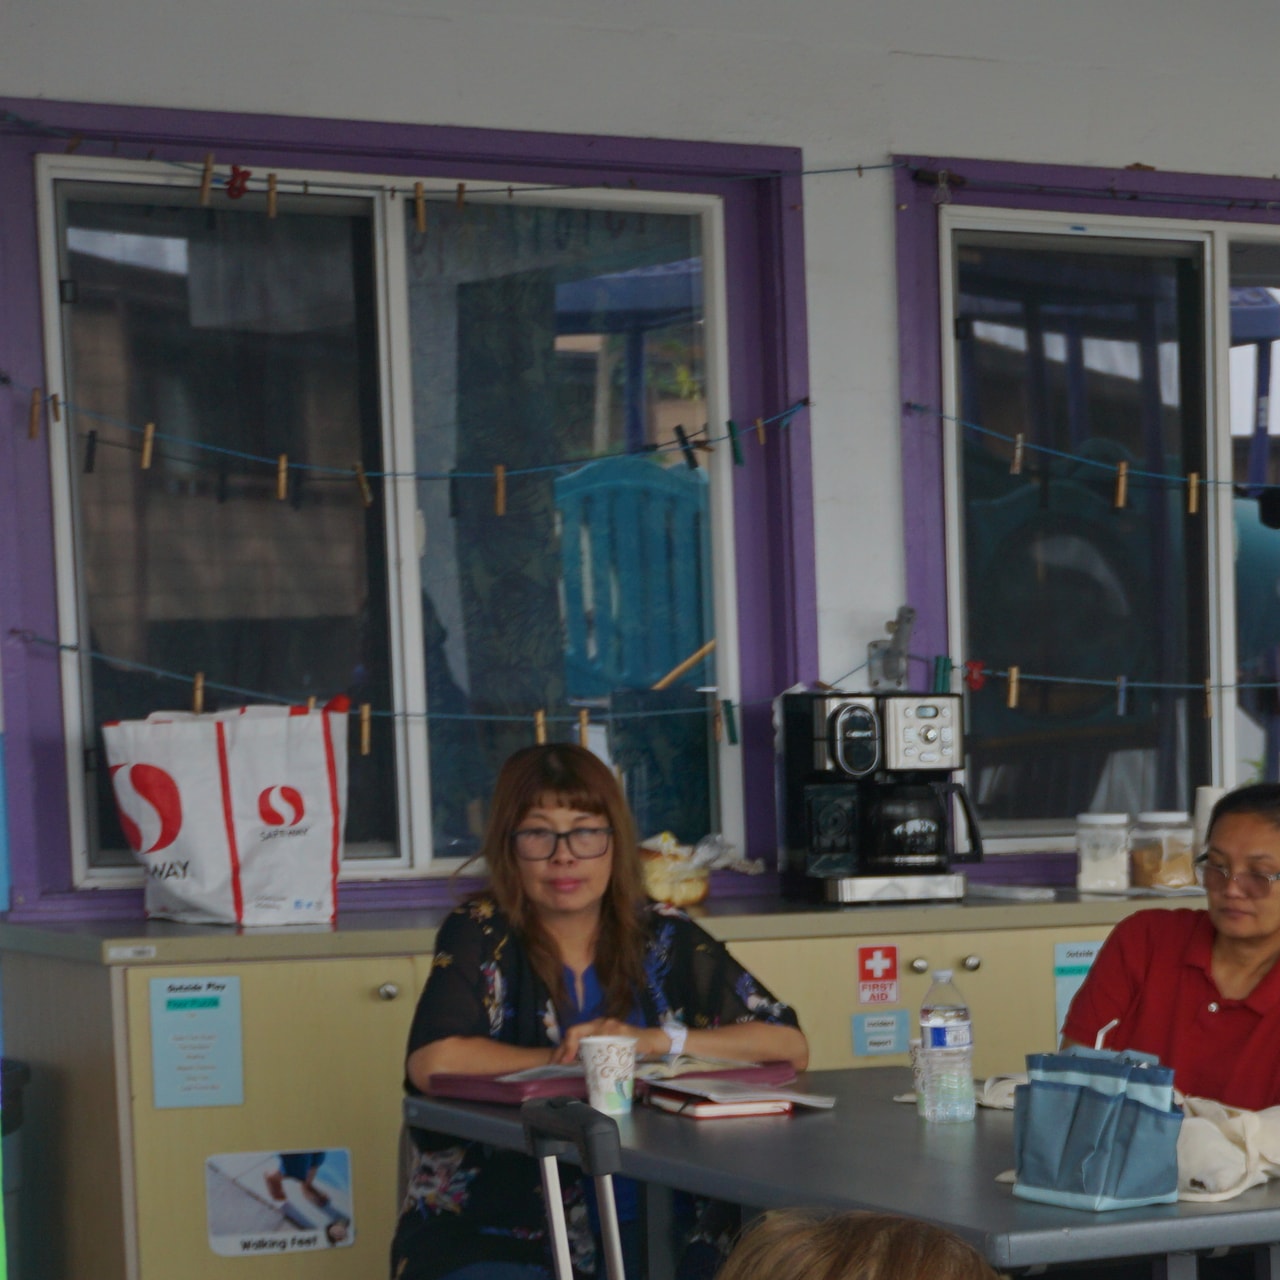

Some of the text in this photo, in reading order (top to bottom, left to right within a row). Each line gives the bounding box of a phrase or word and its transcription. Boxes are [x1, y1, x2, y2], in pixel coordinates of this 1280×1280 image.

[167, 982, 226, 993] Outside Play
[861, 983, 894, 993] FIRST
[868, 992, 888, 1002] AID
[240, 1236, 317, 1253] Walking Feet
